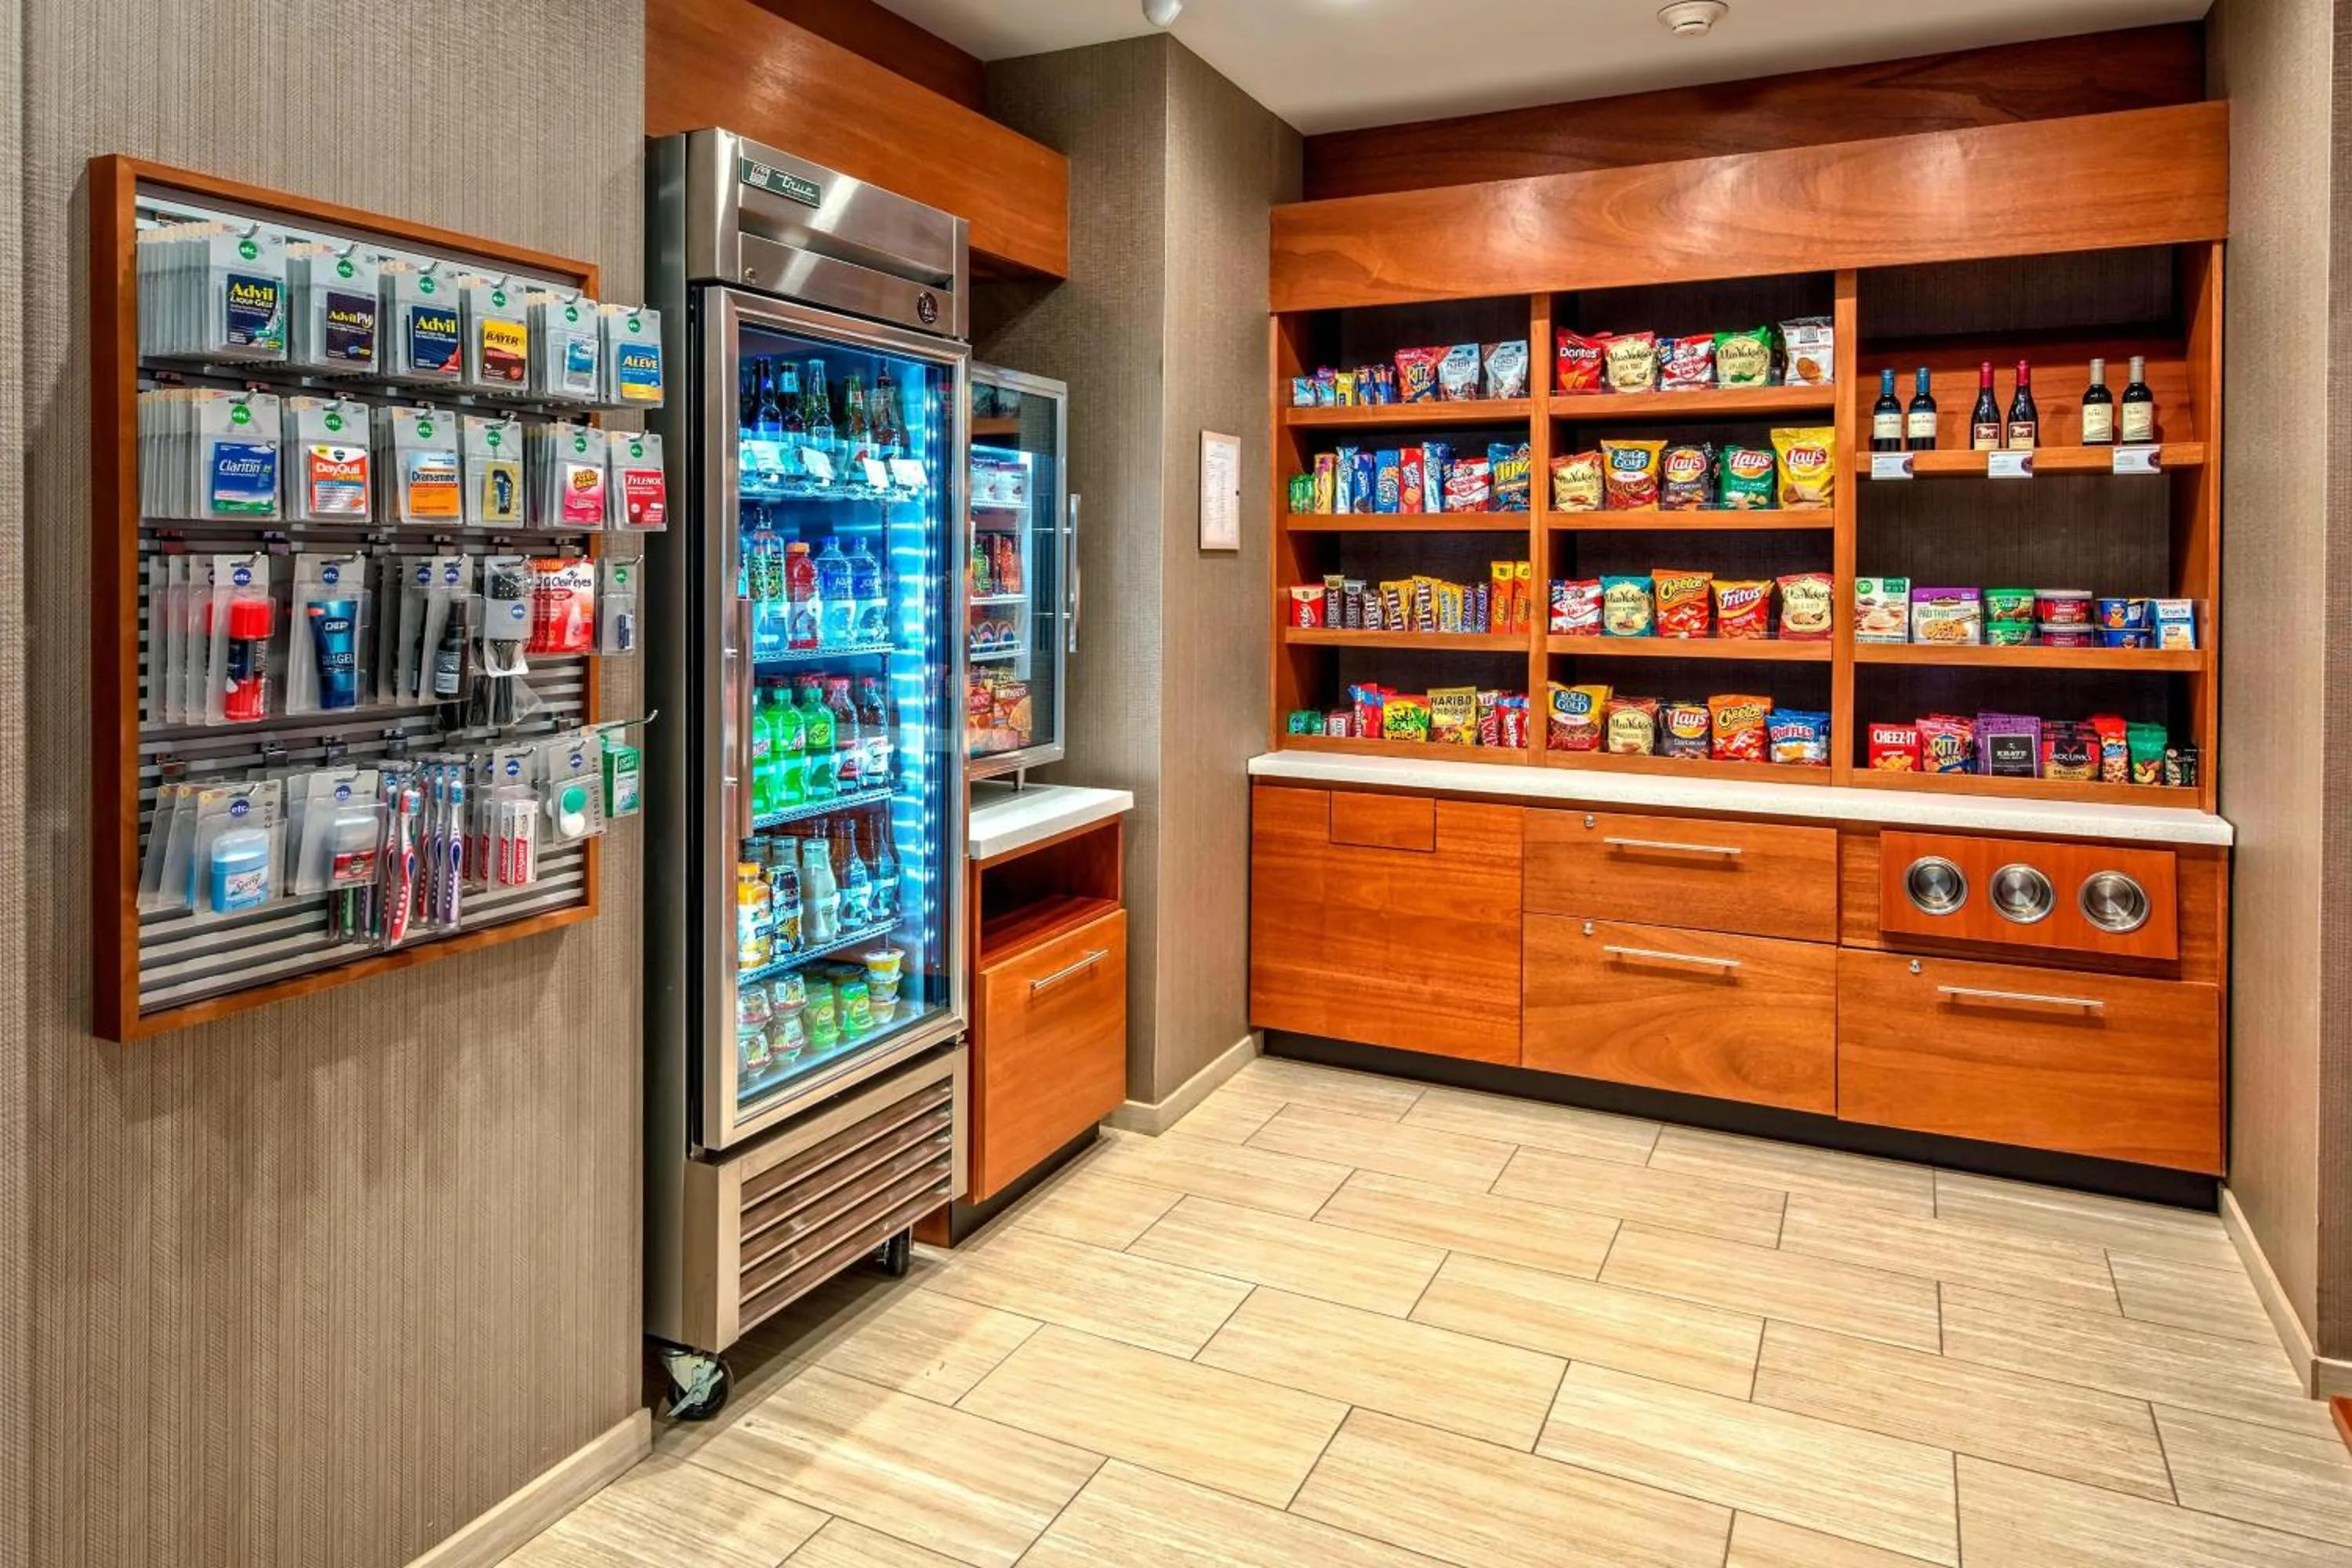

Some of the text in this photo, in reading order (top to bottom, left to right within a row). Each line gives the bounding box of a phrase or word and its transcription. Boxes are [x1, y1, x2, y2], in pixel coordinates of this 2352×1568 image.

[231, 282, 274, 301] Advil
[328, 310, 359, 323] Advil
[416, 314, 456, 333] Advil
[485, 331, 520, 346] BAYER
[1559, 347, 1601, 358] Doritos
[622, 356, 659, 369] ALEVE
[220, 459, 260, 474] Claritin
[316, 463, 361, 478] DayQuil
[412, 470, 457, 483] Dramamine
[626, 474, 663, 485] TYLENOL
[551, 577, 592, 589] Clear eyes
[1661, 577, 1707, 599] Cheetos
[1722, 588, 1760, 608] Fritos
[1431, 695, 1472, 706] HARIBO
[1770, 724, 1814, 740] RUFFLES
[1930, 737, 1961, 756] RITZ
